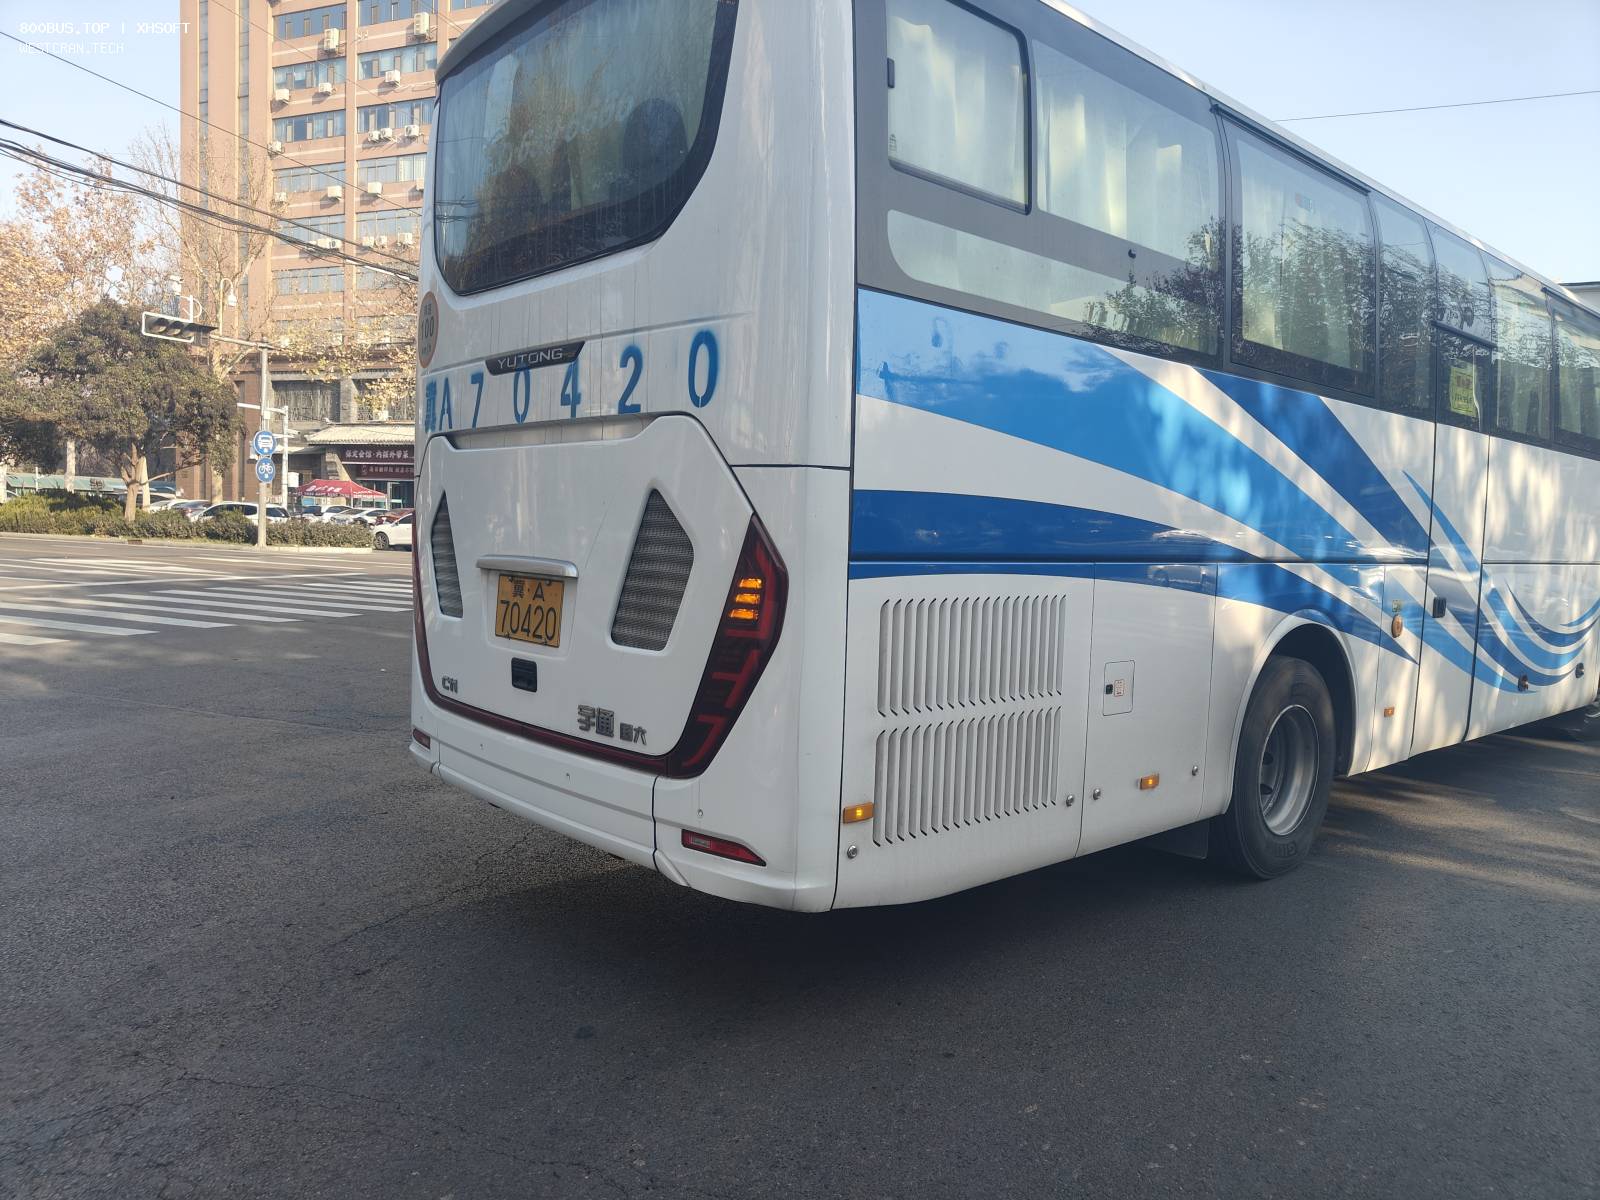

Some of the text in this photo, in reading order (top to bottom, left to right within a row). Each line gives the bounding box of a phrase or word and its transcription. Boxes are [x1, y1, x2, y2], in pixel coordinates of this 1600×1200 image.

[420, 315, 435, 341] 100
[497, 347, 563, 369] YUTONG
[500, 600, 557, 640] 70420
